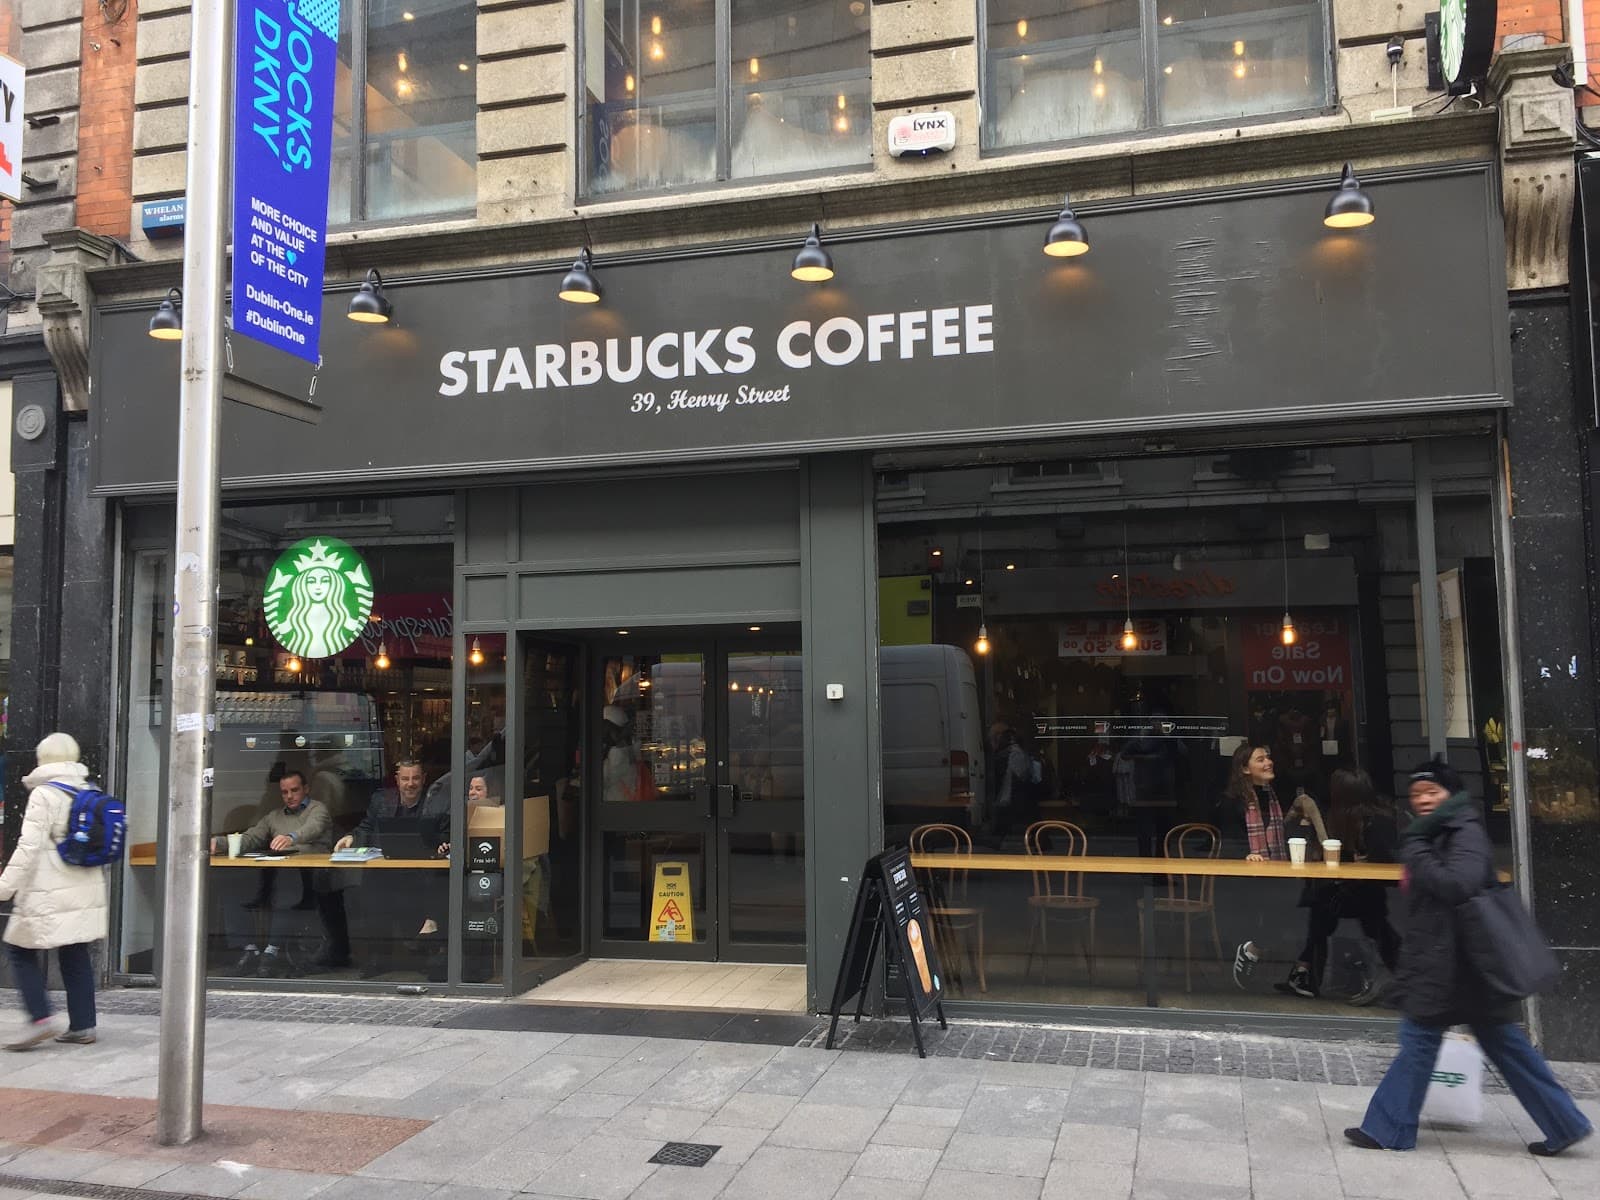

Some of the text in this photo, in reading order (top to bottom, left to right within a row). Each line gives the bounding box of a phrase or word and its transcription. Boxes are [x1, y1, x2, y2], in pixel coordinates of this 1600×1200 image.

[253, 8, 281, 159] DKNY
[913, 119, 945, 131] LYNX
[144, 204, 184, 216] WHELAN
[159, 214, 184, 222] alarms
[251, 197, 318, 243] MORE CHOICE
[250, 233, 285, 260] AT THE
[251, 215, 305, 253] AND VALUE
[250, 250, 309, 288] OF THE CITY
[246, 283, 314, 326] Dublin-One.ie
[246, 309, 305, 345] #DublinOne
[438, 304, 994, 397] STARBUCKS COFFEE
[630, 384, 791, 415] 39, Henry Street
